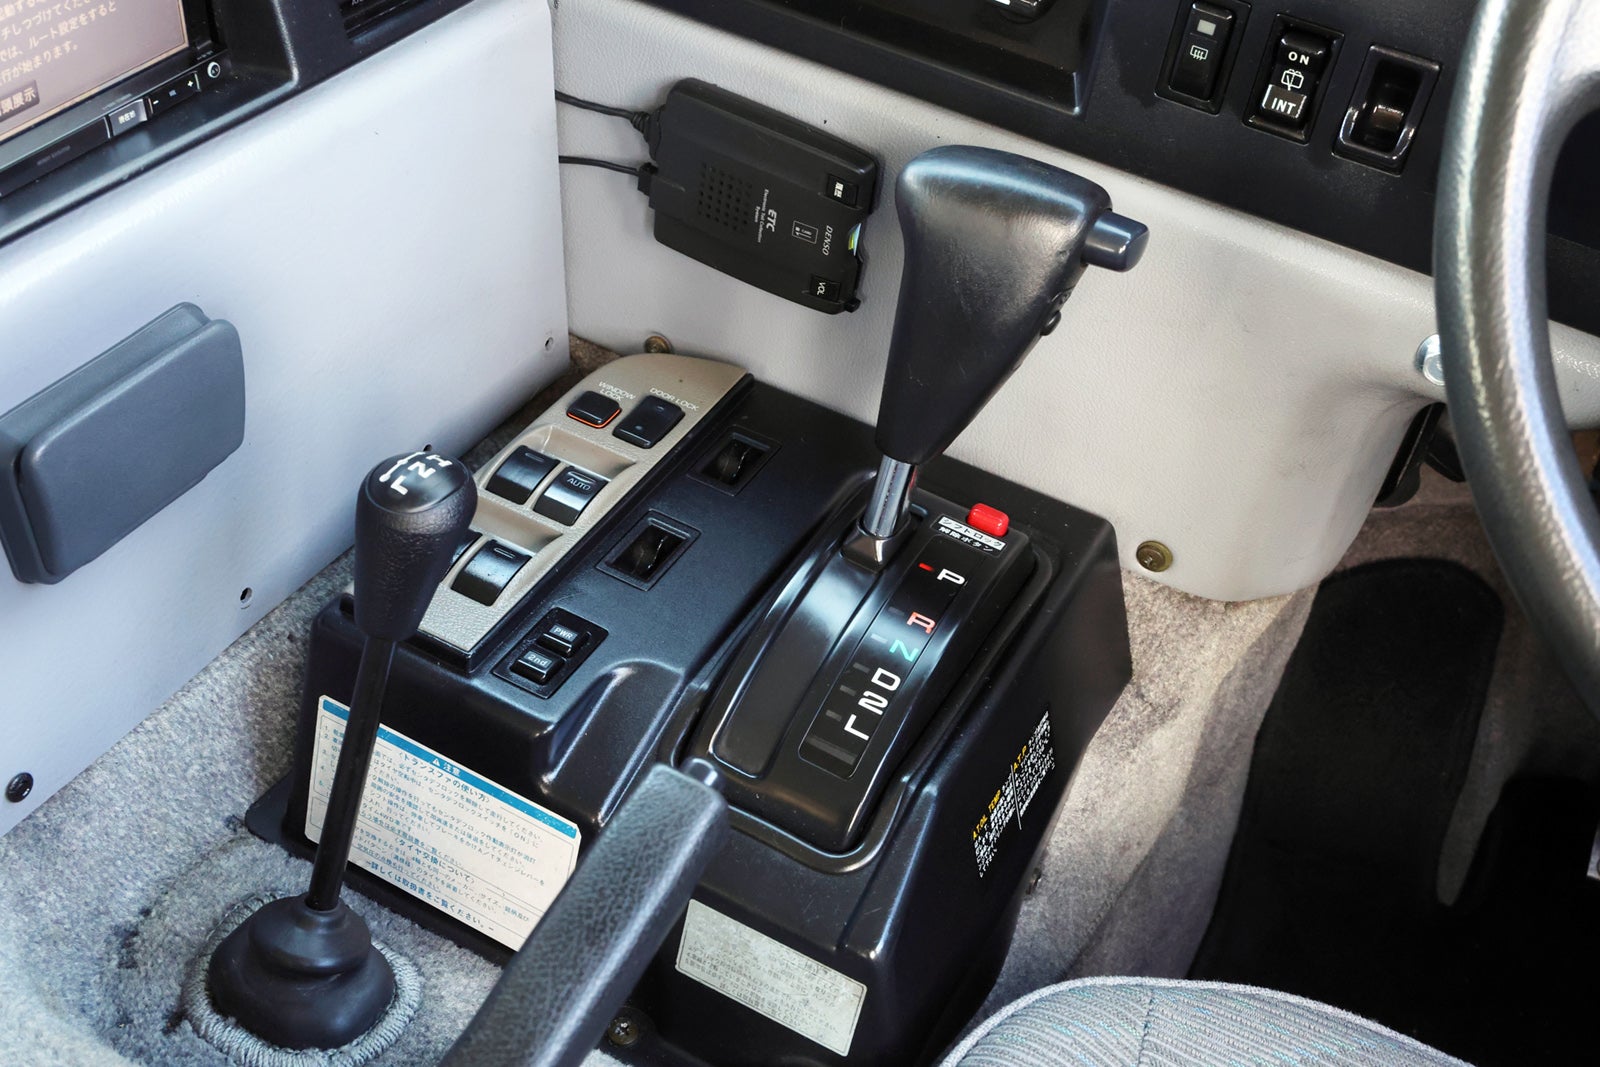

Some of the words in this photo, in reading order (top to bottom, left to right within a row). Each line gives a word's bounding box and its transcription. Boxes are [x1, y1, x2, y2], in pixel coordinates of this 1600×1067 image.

[0, 40, 78, 84] 行が始まります。
[1288, 51, 1310, 65] ON
[0, 87, 36, 116] 頭展示
[1271, 97, 1296, 114] INT
[766, 208, 777, 232] ETC
[822, 225, 833, 256] DENSO
[817, 282, 826, 295] VOL
[599, 381, 636, 400] WINDOW
[600, 388, 624, 401] LOCK
[649, 387, 675, 401] DOOR
[675, 398, 699, 411] LOCK
[407, 461, 436, 479] N
[390, 475, 408, 495] L
[567, 477, 591, 491] AUTO
[936, 568, 966, 586] P
[906, 611, 936, 634] R
[554, 627, 574, 639] PWR
[527, 654, 548, 665] 2nd
[889, 639, 919, 662] N
[870, 667, 901, 692] D
[857, 690, 889, 716] 2
[843, 714, 870, 741] L
